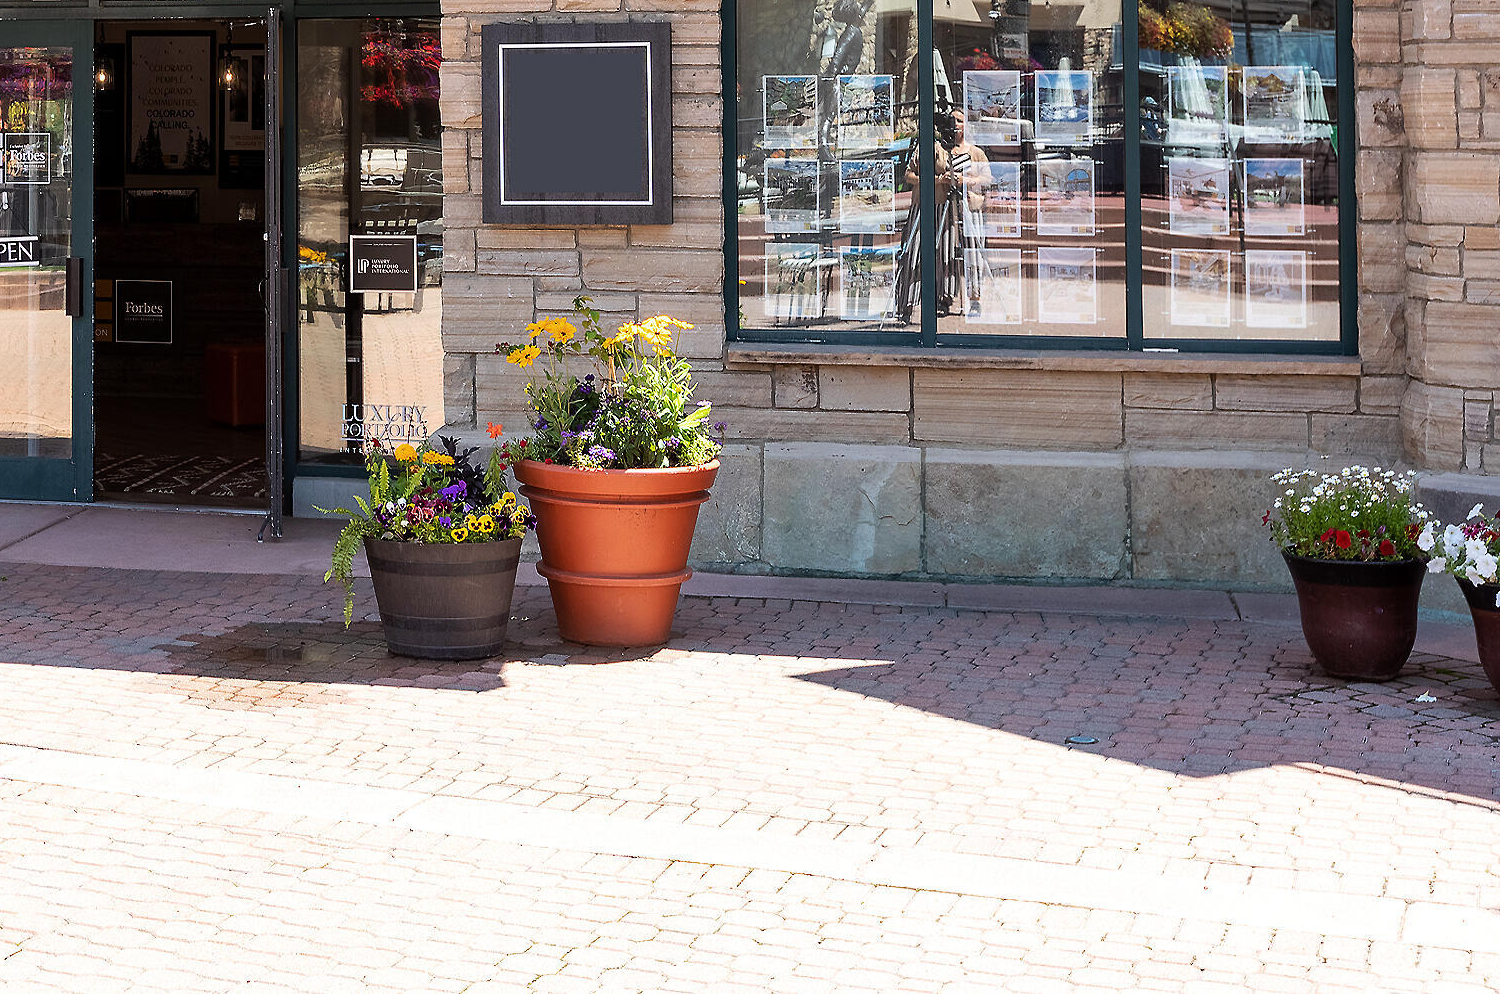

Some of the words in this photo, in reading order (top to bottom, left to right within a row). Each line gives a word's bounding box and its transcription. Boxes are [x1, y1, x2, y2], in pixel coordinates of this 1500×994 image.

[148, 64, 193, 72] COLORADO
[148, 87, 193, 95] COLORADO
[146, 109, 195, 118] COLORADO
[150, 120, 190, 129] CALLING.
[9, 149, 46, 161] Forbes
[125, 301, 163, 314] Forbes
[341, 404, 427, 423] LUXURY
